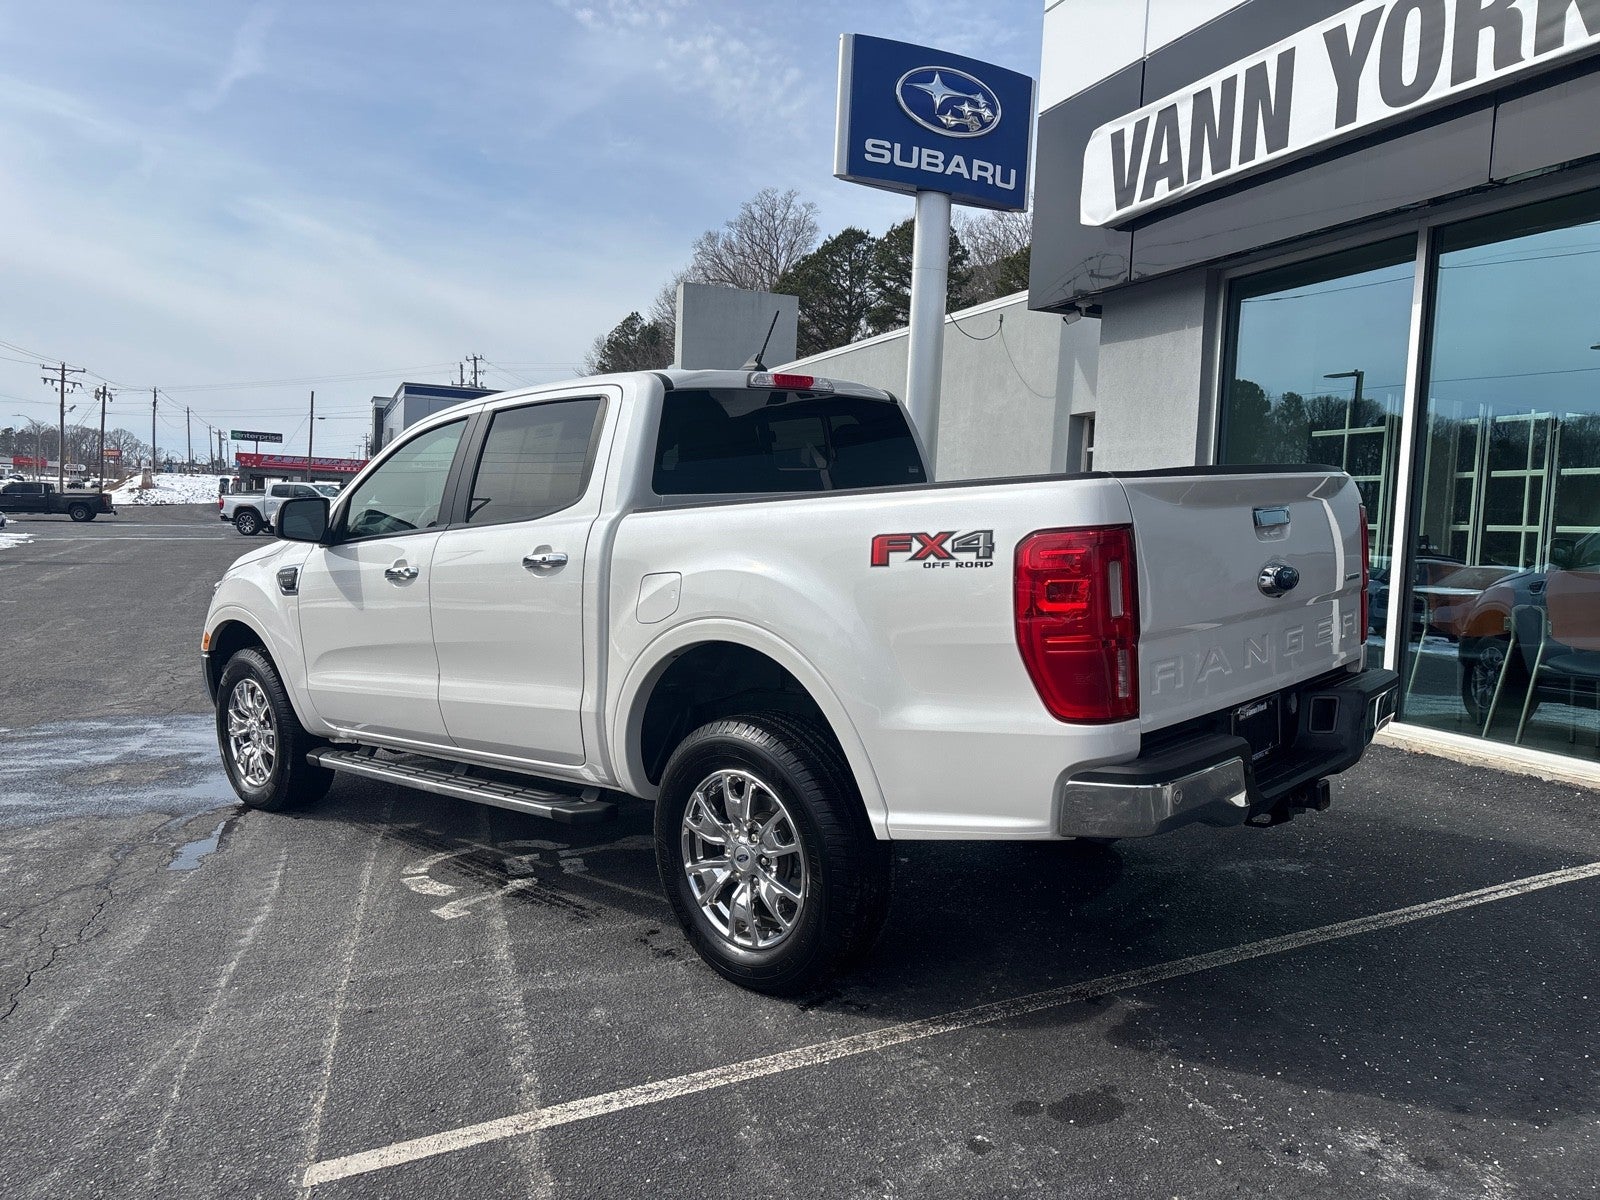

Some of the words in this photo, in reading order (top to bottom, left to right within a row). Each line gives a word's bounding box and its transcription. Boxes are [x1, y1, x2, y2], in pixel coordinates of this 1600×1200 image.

[1110, 46, 1296, 211] VANN
[864, 138, 1017, 191] SUBARU
[233, 432, 282, 441] enterprise
[870, 530, 995, 567] FX4
[1151, 608, 1358, 696] RANGER
